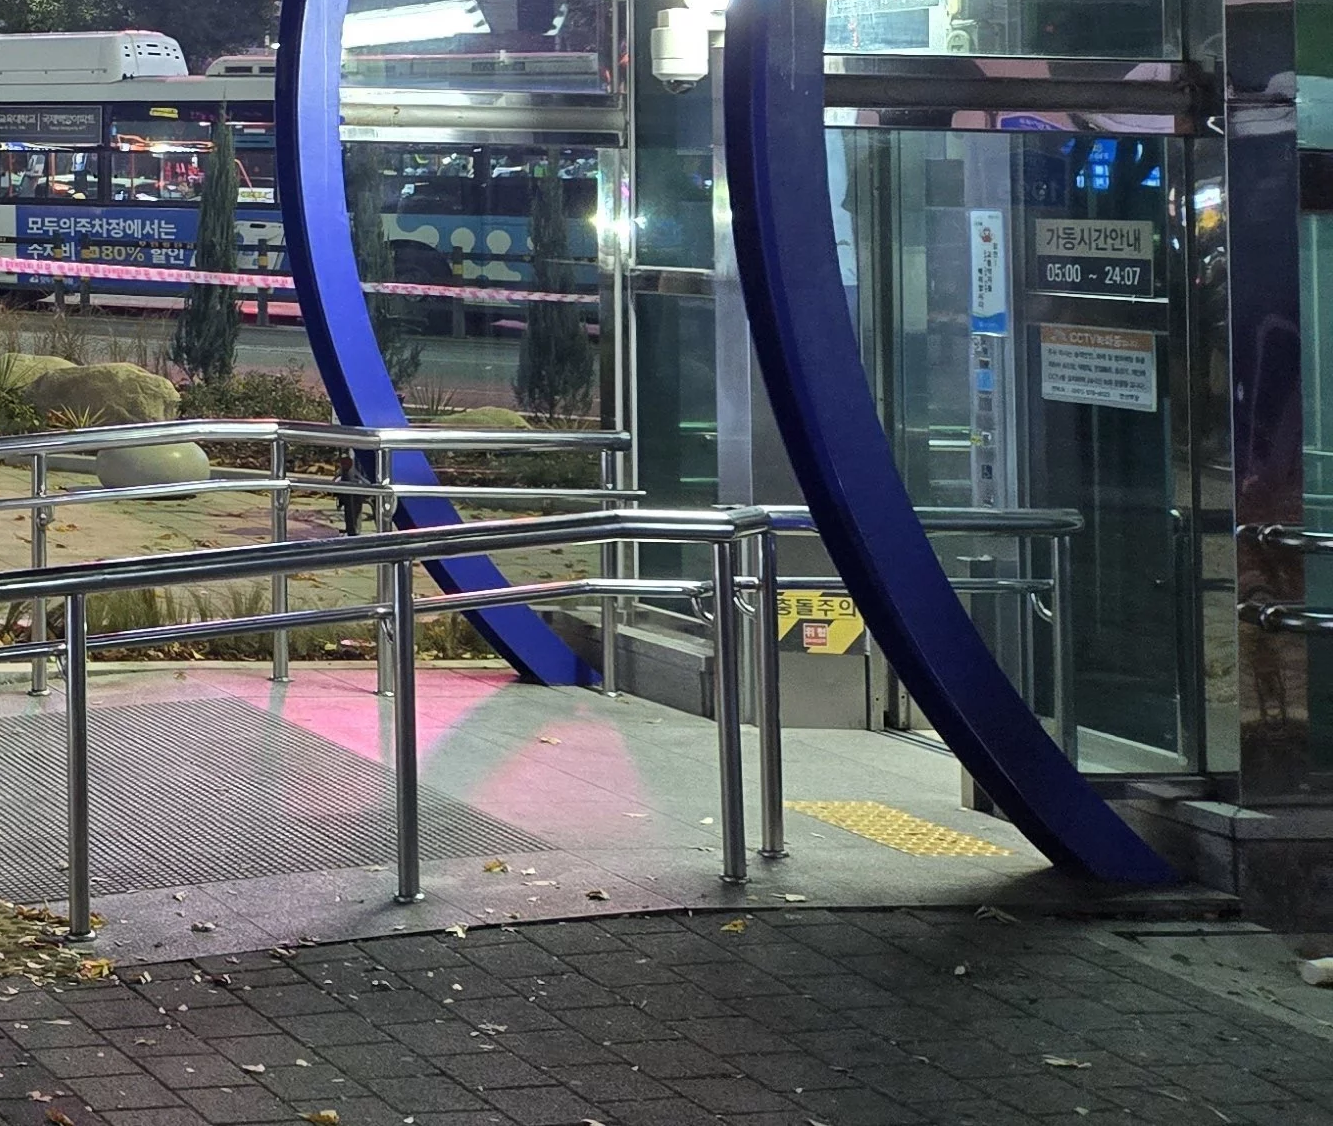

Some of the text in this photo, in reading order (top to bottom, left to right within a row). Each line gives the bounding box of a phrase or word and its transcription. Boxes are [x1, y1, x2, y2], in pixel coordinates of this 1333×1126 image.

[27, 217, 177, 239] 모두의주차장에서는
[1046, 227, 1142, 253] 가동시간안내
[150, 247, 185, 264] 할인
[1047, 264, 1081, 282] 05:00
[1105, 266, 1141, 285] 24:07
[777, 598, 856, 617] 충돌주의
